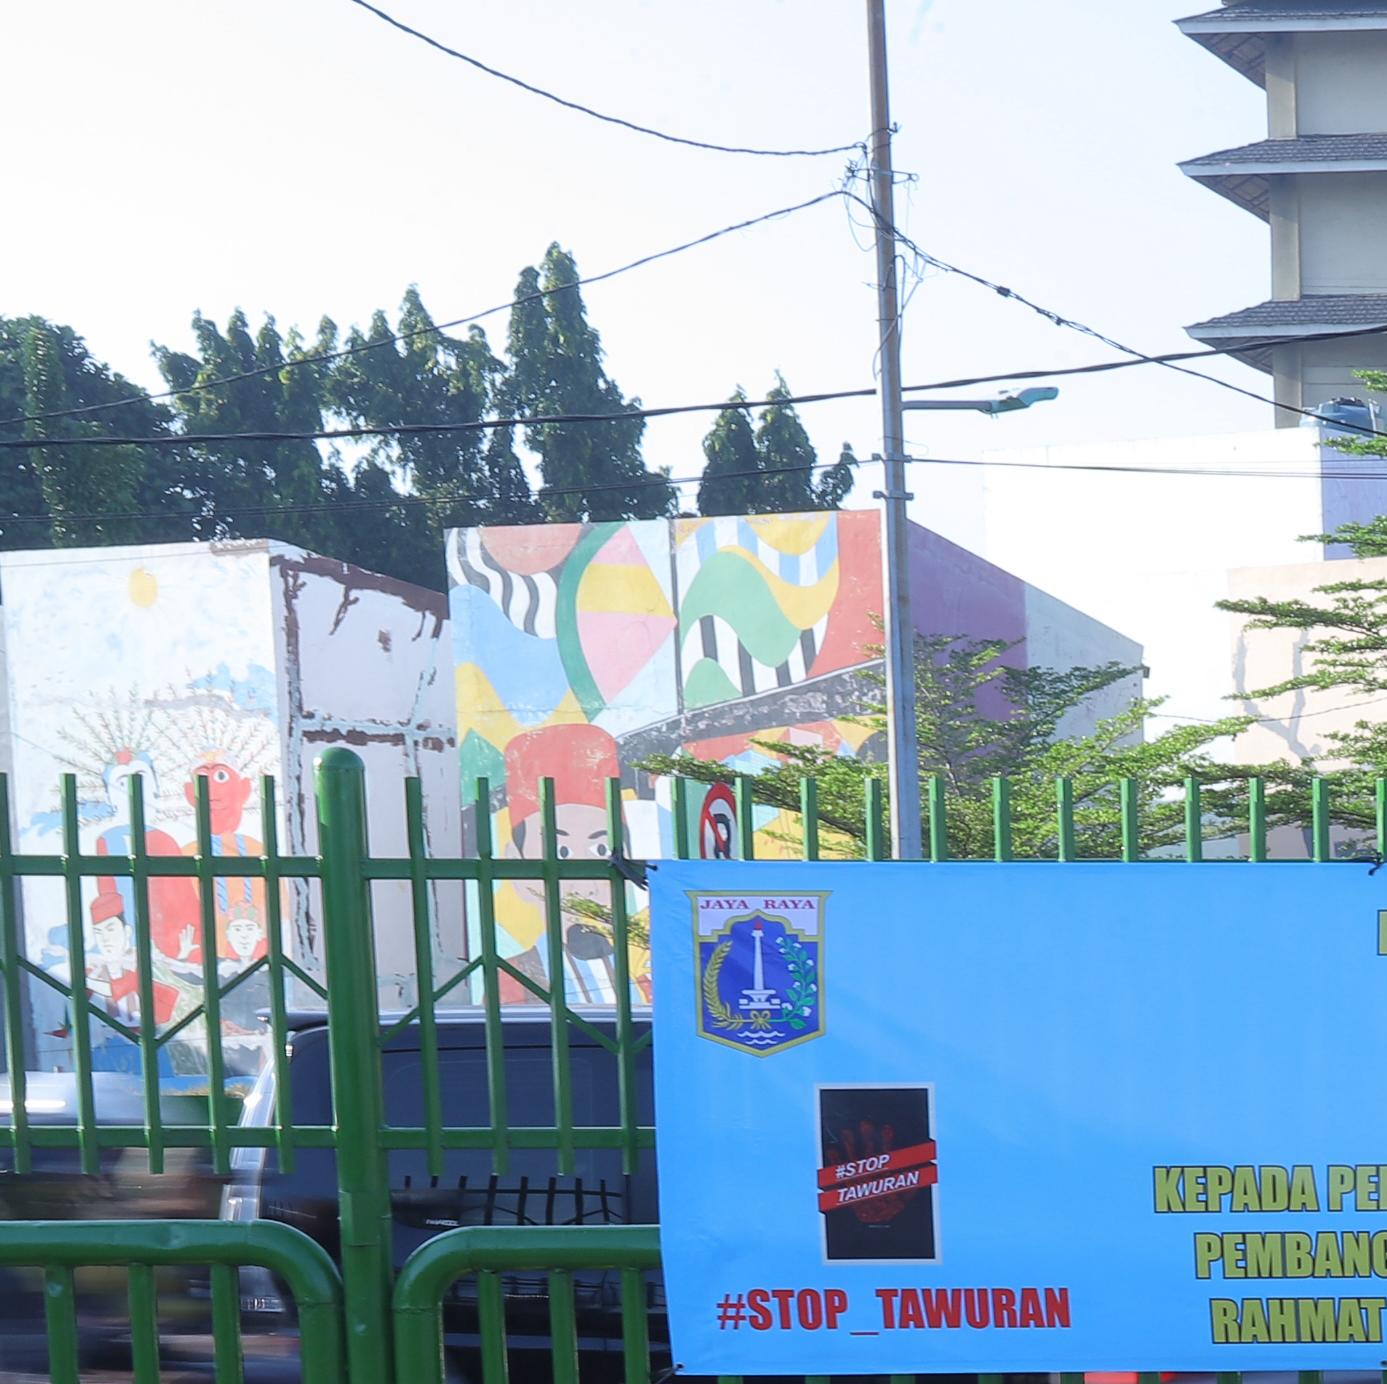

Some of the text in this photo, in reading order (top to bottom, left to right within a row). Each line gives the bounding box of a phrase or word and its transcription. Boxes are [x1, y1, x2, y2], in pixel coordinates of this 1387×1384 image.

[700, 899, 816, 910] JAYA RAYA
[835, 1154, 890, 1179] #STOP
[837, 1171, 919, 1202] TAWURAN
[1153, 1165, 1320, 1213] KEPADA
[717, 1288, 1070, 1335] #STOP_TAWURAN
[1210, 1297, 1387, 1344] RAHMAT
